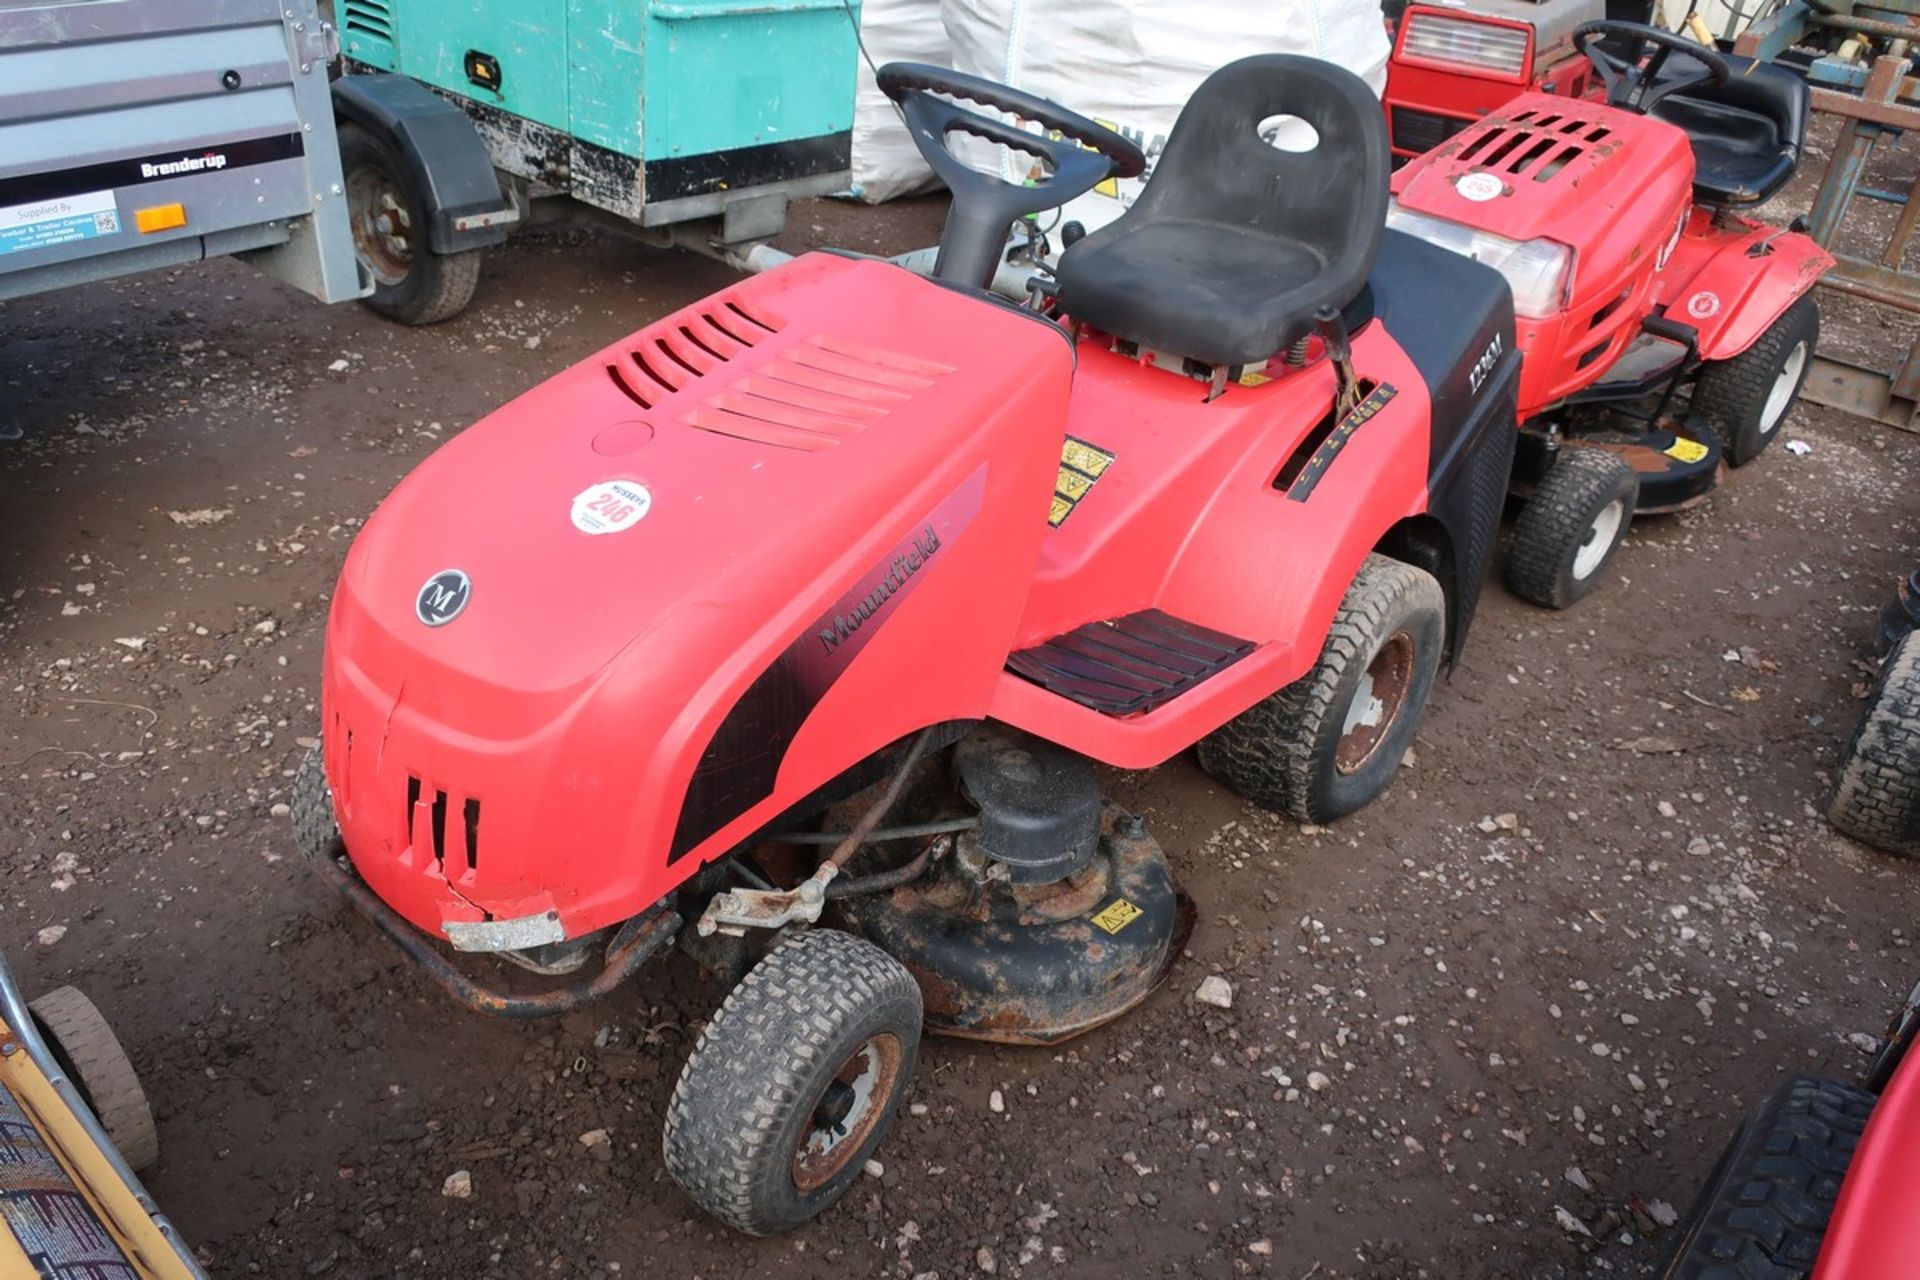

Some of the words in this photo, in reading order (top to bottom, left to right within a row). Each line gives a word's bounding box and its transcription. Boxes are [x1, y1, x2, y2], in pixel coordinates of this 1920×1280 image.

[17, 206, 58, 219] Supplied
[60, 203, 71, 213] By
[587, 494, 635, 523] 246
[425, 583, 457, 612] M
[819, 526, 941, 655] Mountfield
